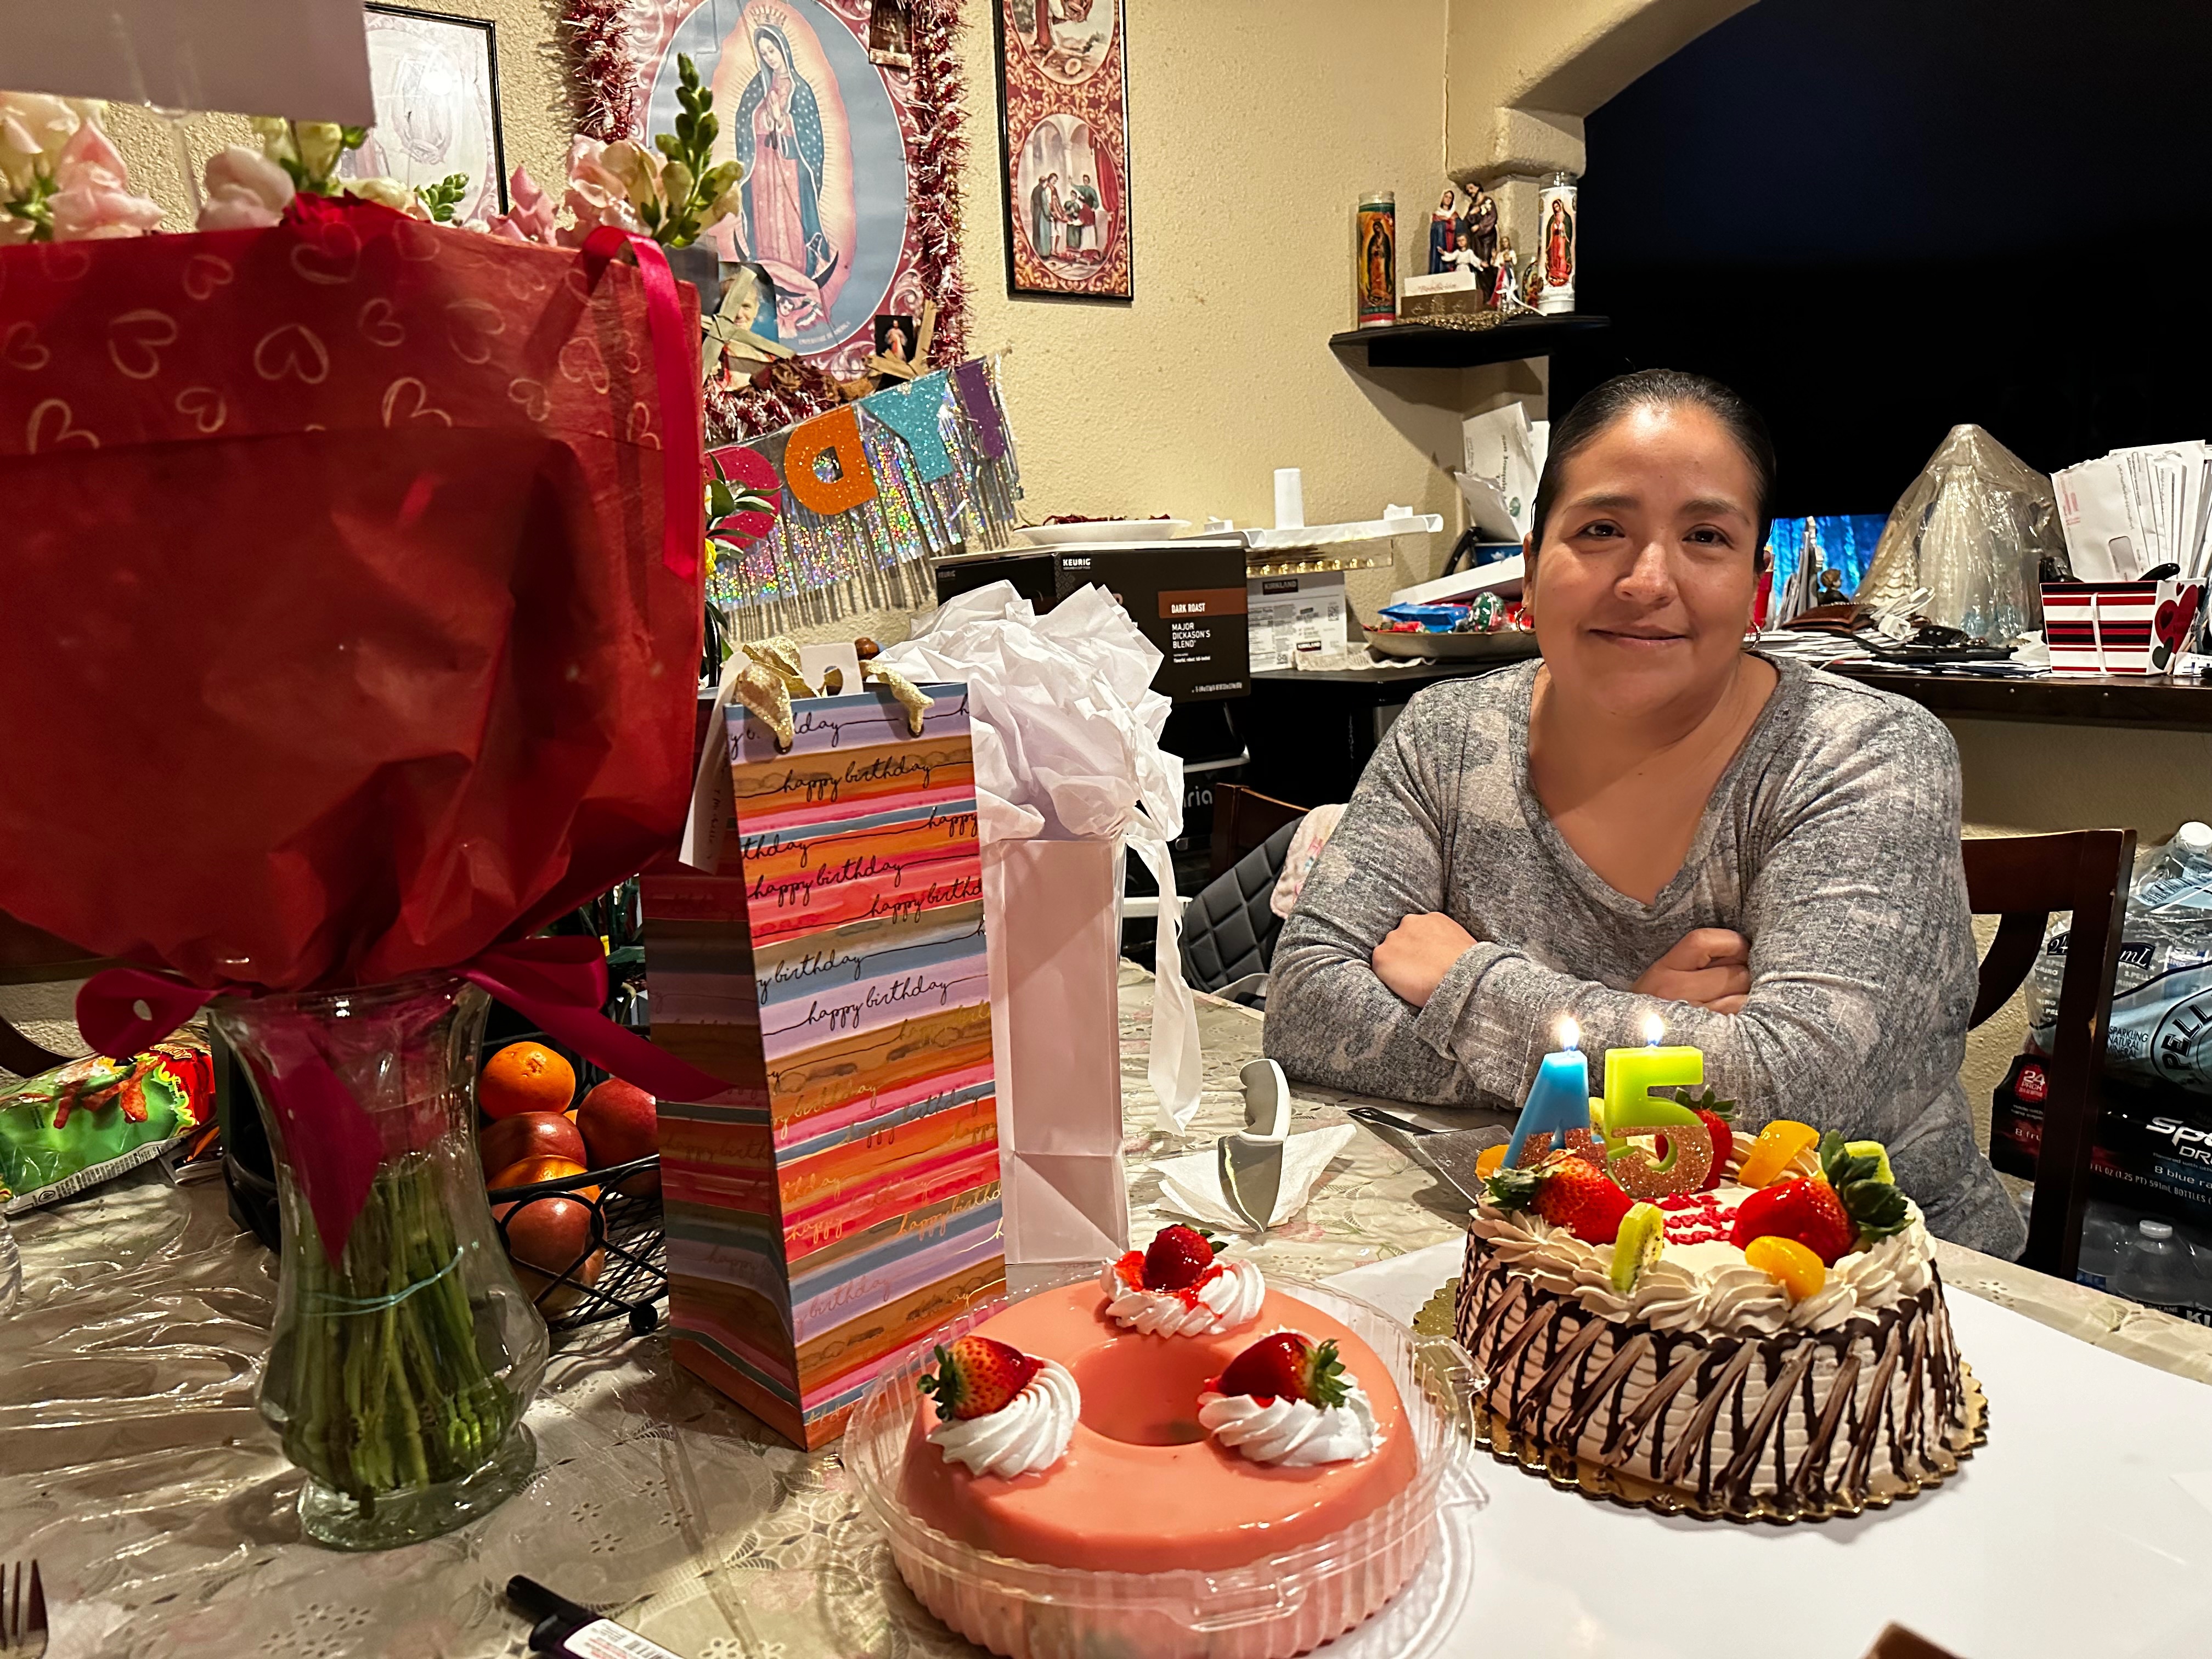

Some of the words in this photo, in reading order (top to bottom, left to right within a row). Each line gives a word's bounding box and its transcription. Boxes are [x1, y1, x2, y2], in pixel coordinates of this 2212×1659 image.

[1063, 558, 1091, 567] KEURIG
[1263, 581, 1296, 590] KIRKLAND
[1171, 604, 1187, 613] DARK
[1188, 602, 1205, 613] ROAST
[1172, 622, 1194, 631] MAJOR
[1172, 630, 1211, 640] DICKASON'S
[782, 770, 843, 802] happy
[845, 757, 933, 788] birthday
[928, 807, 978, 837] happy
[749, 874, 814, 907] happy
[816, 855, 904, 887] birthday
[868, 896, 926, 924] happy
[775, 949, 864, 983] birthday
[2119, 947, 2151, 967] mL
[805, 1001, 864, 1030] happy
[866, 978, 949, 1008] birthday
[2108, 1025, 2149, 1043] SPARKLING
[2108, 1035, 2140, 1051] NATURAL
[2021, 1081, 2042, 1092] PACK
[2023, 1070, 2045, 1086] 24
[2016, 1128, 2023, 1136] 8
[2179, 1146, 2212, 1165] DR
[2154, 1165, 2163, 1174] 8
[2167, 1169, 2195, 1184] blue
[2174, 1186, 2206, 1203] BOTTLES
[896, 1211, 948, 1241] happy
[809, 1276, 891, 1318] birthday
